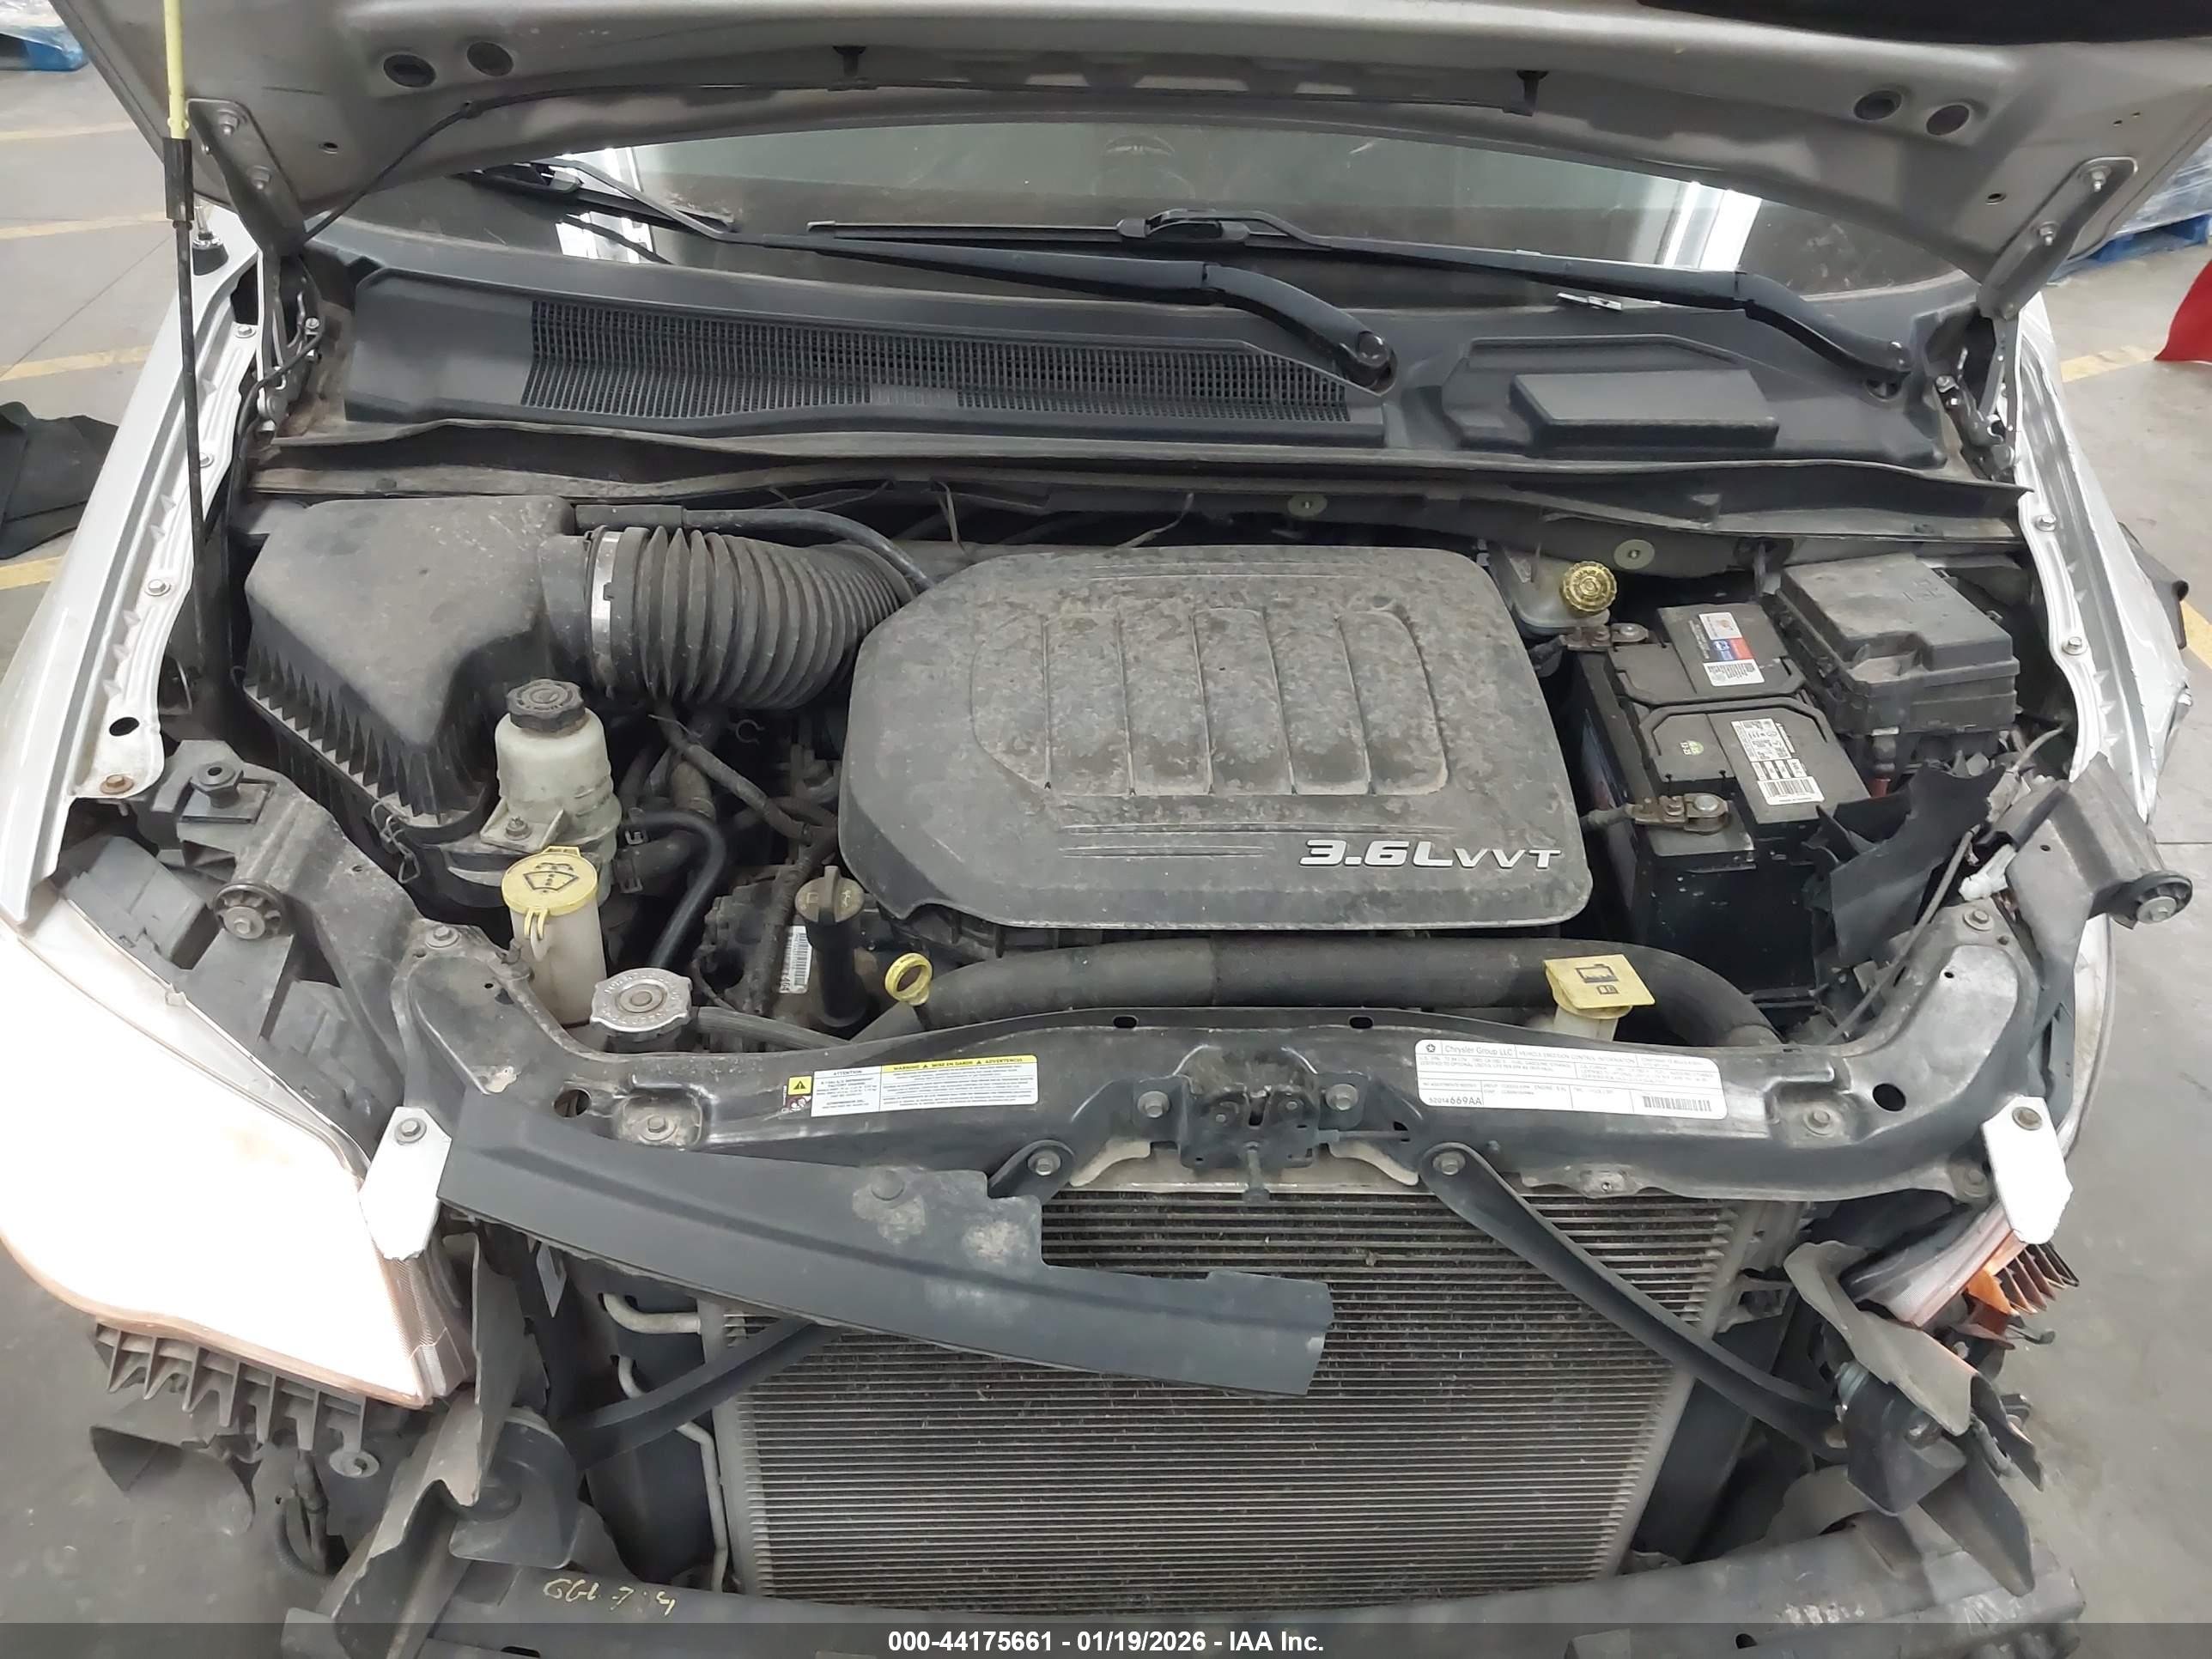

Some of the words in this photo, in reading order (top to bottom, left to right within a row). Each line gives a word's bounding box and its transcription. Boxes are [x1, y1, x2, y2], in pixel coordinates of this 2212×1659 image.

[1299, 840, 1454, 866] 3.6L
[1454, 848, 1562, 869] VVT
[1444, 1045, 1474, 1056] Chrysler
[1476, 1047, 1498, 1057] Group
[1499, 1048, 1513, 1057] LLC
